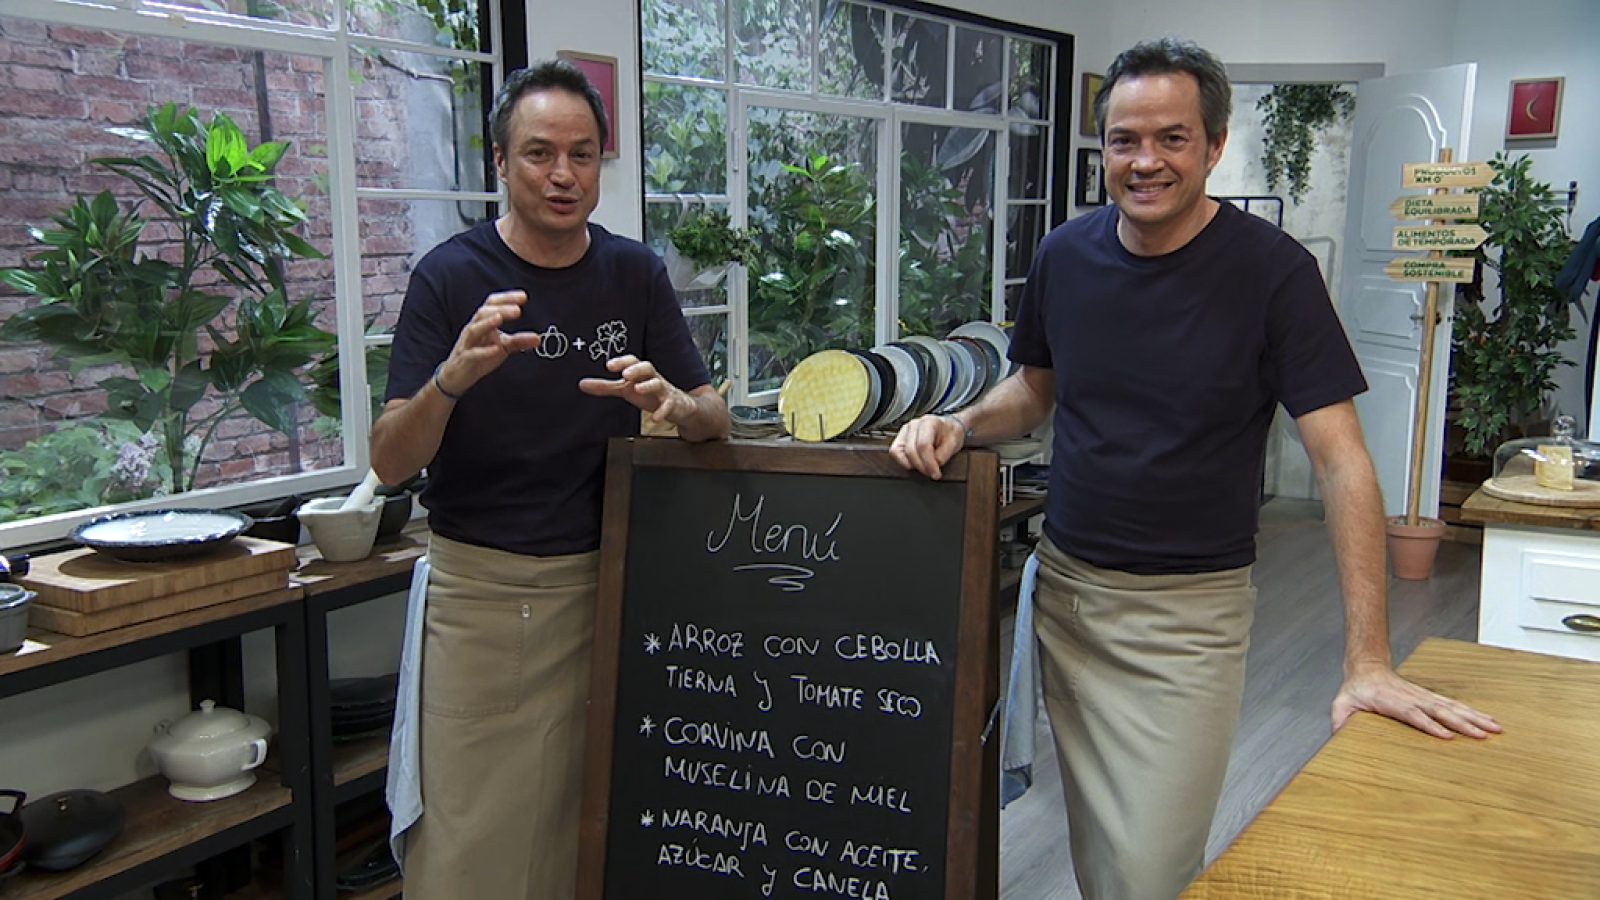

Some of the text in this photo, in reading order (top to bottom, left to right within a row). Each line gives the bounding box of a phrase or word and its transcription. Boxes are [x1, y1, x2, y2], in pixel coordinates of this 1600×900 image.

[1405, 199, 1433, 207] DIETA
[1405, 206, 1472, 215] EQUILIBRADA
[1396, 229, 1456, 238] ALIMENTOS
[1398, 238, 1476, 246] DE TEMPORADA
[1403, 261, 1446, 269] COMPRA
[1403, 269, 1464, 279] SOSTENIBLE
[706, 493, 842, 562] Menú
[668, 622, 942, 665] ARROZ CON CEBOLLA
[789, 673, 865, 709] TOMATE
[876, 687, 922, 718] SECO
[663, 716, 847, 764] CORVINA CON
[805, 778, 838, 804] DE
[849, 784, 913, 813] MIEL
[661, 808, 768, 851] NARANJA
[784, 830, 830, 857] CON
[657, 836, 745, 878] AZÚCAR
[792, 866, 891, 900] CANELA
